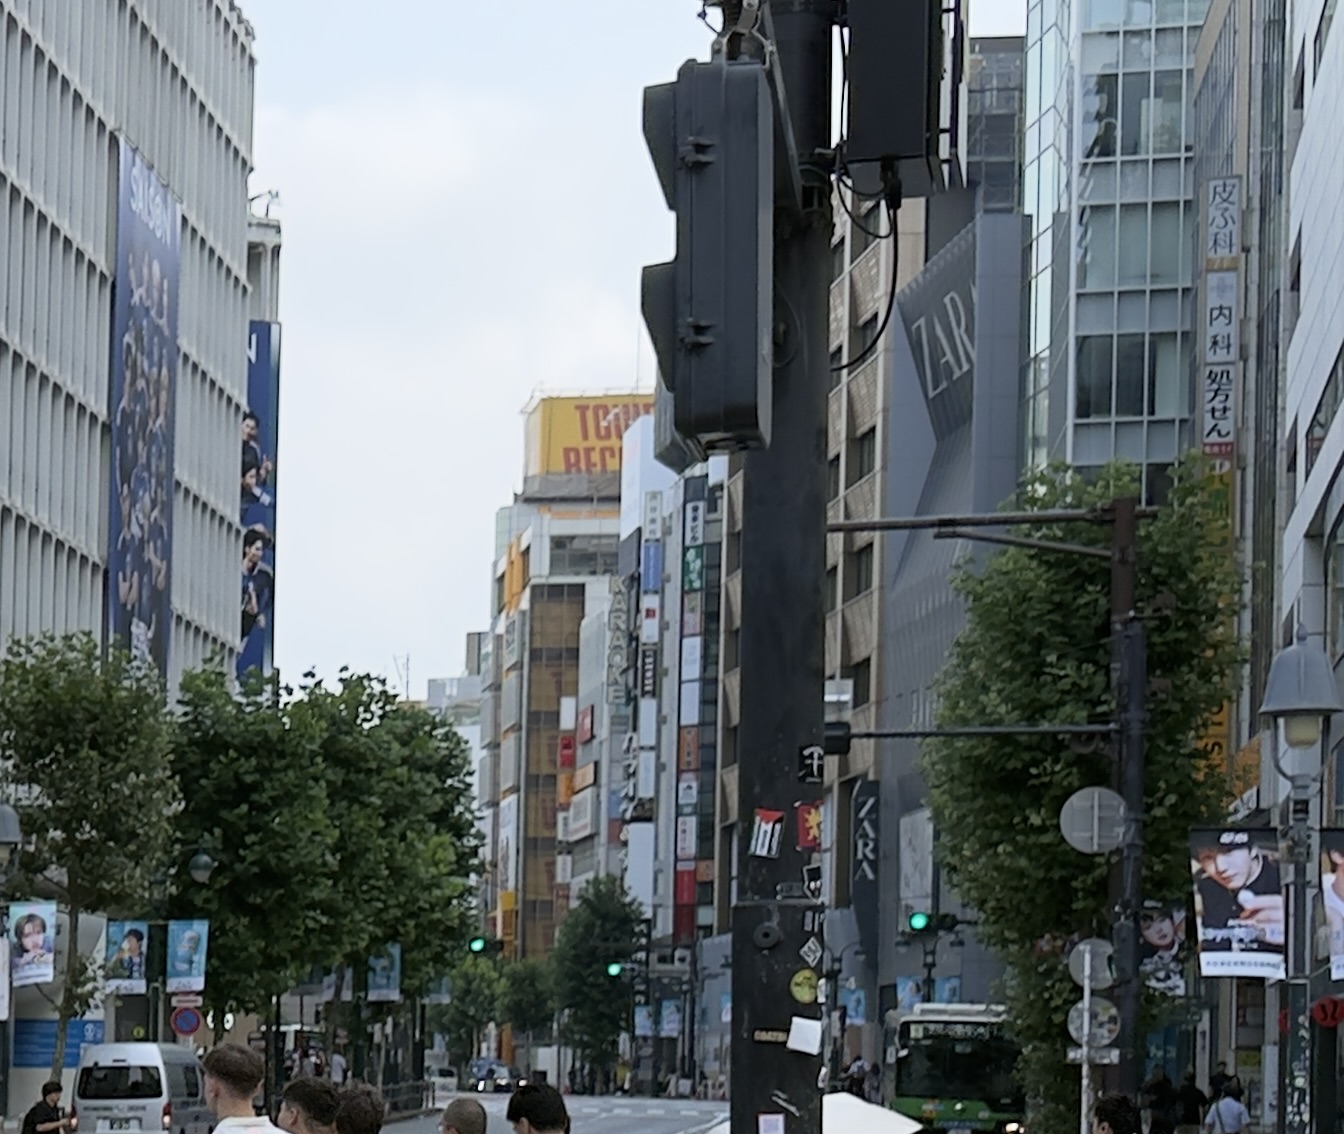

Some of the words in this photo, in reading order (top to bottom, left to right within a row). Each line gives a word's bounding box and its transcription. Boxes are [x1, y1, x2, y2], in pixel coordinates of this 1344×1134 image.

[1209, 181, 1236, 255] 皮ふ科
[912, 290, 976, 399] ZAR
[1209, 304, 1233, 355] 内科
[574, 402, 653, 442] TOW
[1206, 369, 1233, 439] 処方せん
[854, 797, 877, 881] ZARA
